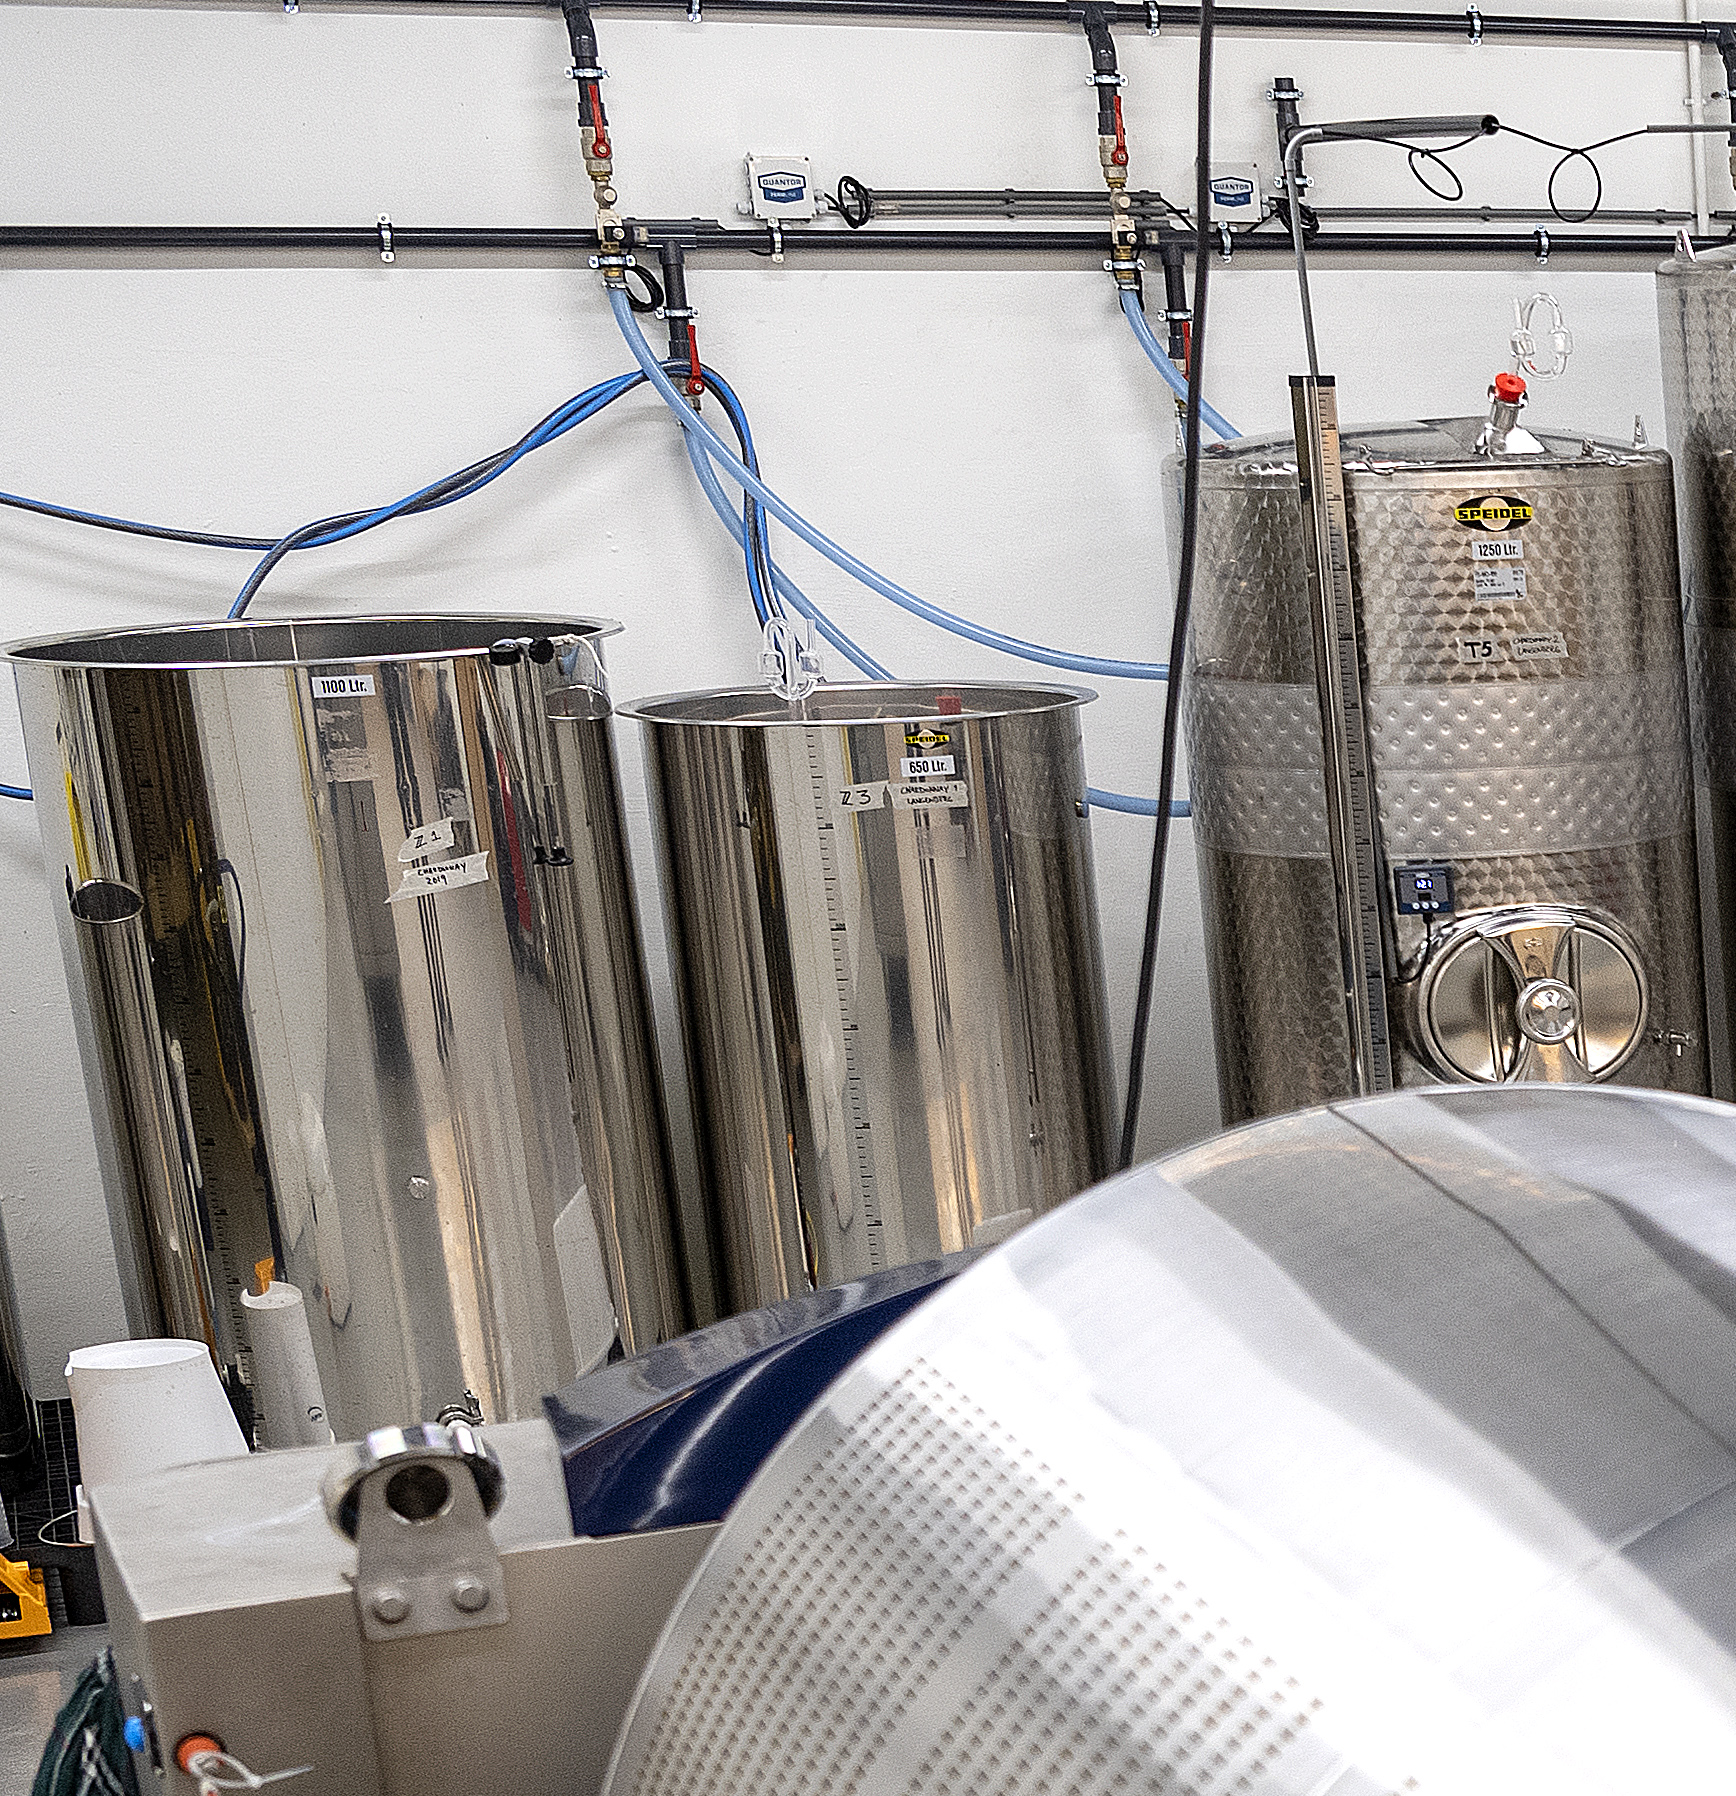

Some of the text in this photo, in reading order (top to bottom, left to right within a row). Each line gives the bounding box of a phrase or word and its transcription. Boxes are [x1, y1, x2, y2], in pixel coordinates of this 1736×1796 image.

[762, 178, 802, 186] QUANTOR
[1458, 508, 1532, 520] SPEIDEL
[1478, 543, 1519, 557] 1250 Ltr.
[1463, 640, 1493, 659] T5
[321, 679, 368, 694] 1100 Ltr.
[909, 761, 948, 774] 650 Ltr.
[856, 789, 871, 805] 3
[430, 830, 442, 842] 1
[425, 874, 448, 885] 2019
